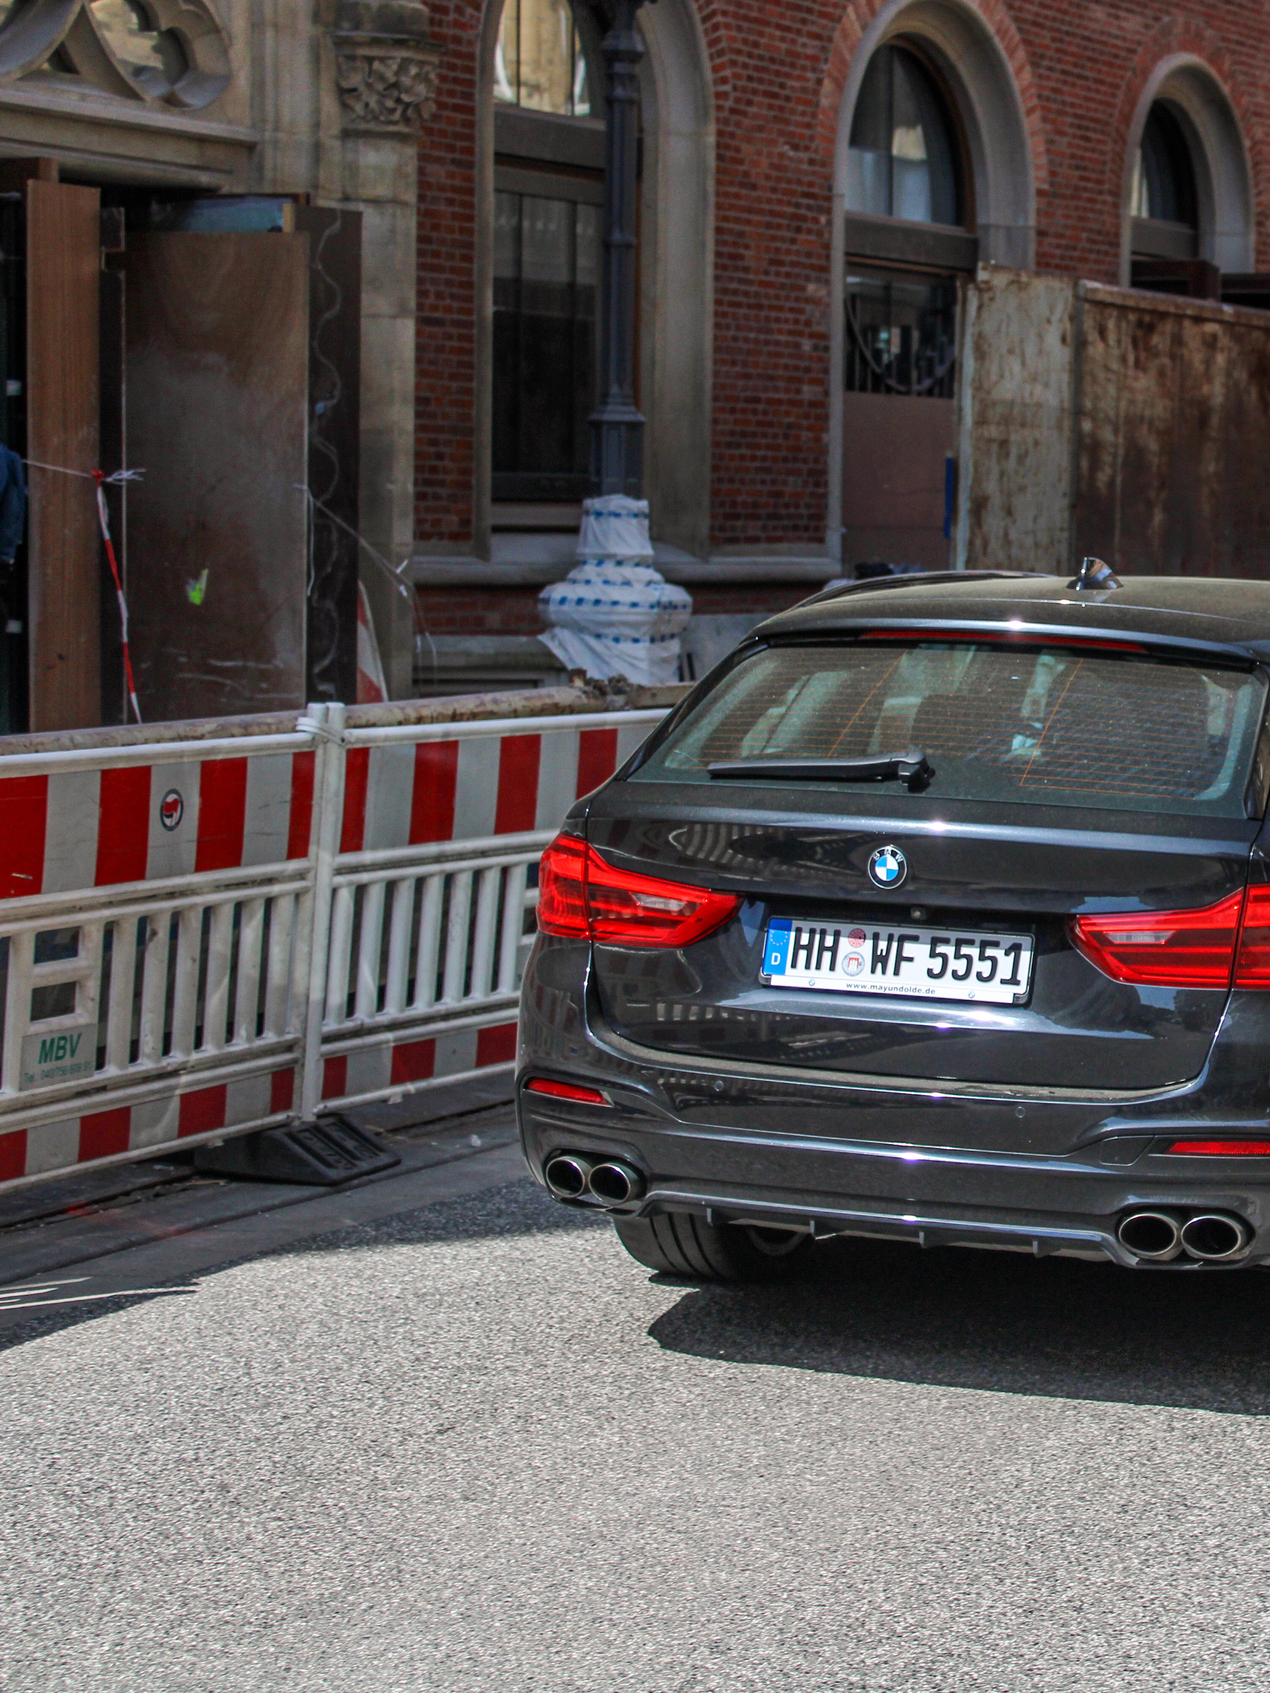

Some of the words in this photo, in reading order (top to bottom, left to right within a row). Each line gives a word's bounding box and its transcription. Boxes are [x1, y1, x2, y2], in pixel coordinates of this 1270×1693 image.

[872, 848, 904, 863] BMW
[771, 952, 781, 965] D
[791, 926, 841, 972] HH
[870, 931, 920, 976] WF
[927, 936, 1022, 986] 5551
[846, 983, 936, 995] www.mayundolde.de
[37, 1032, 82, 1065] MBV
